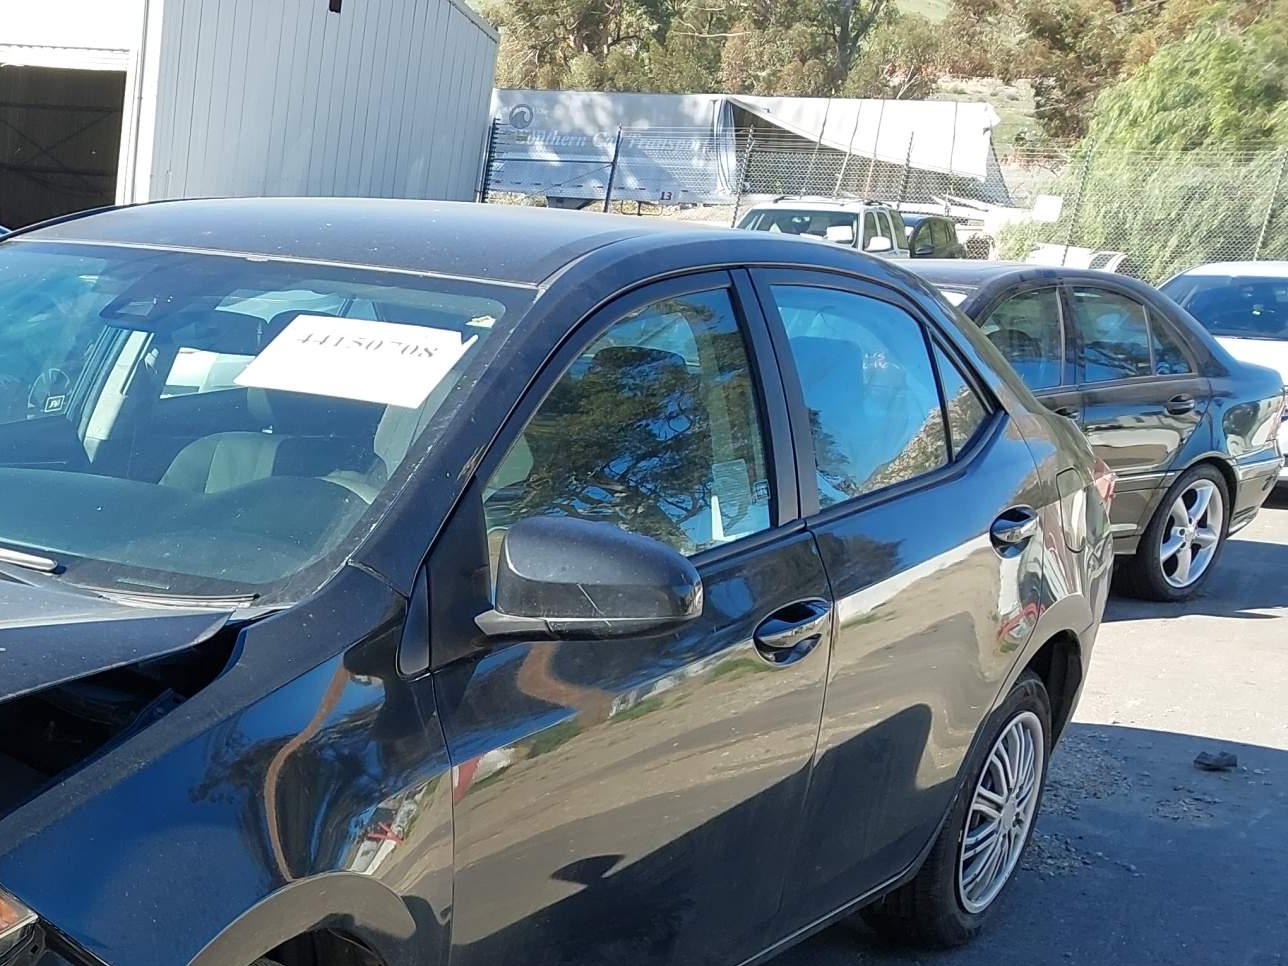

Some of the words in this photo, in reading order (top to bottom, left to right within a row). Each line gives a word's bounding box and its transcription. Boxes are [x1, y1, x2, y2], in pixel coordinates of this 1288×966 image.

[515, 129, 585, 148] Southern
[593, 131, 622, 148] Ca
[660, 191, 672, 200] 13
